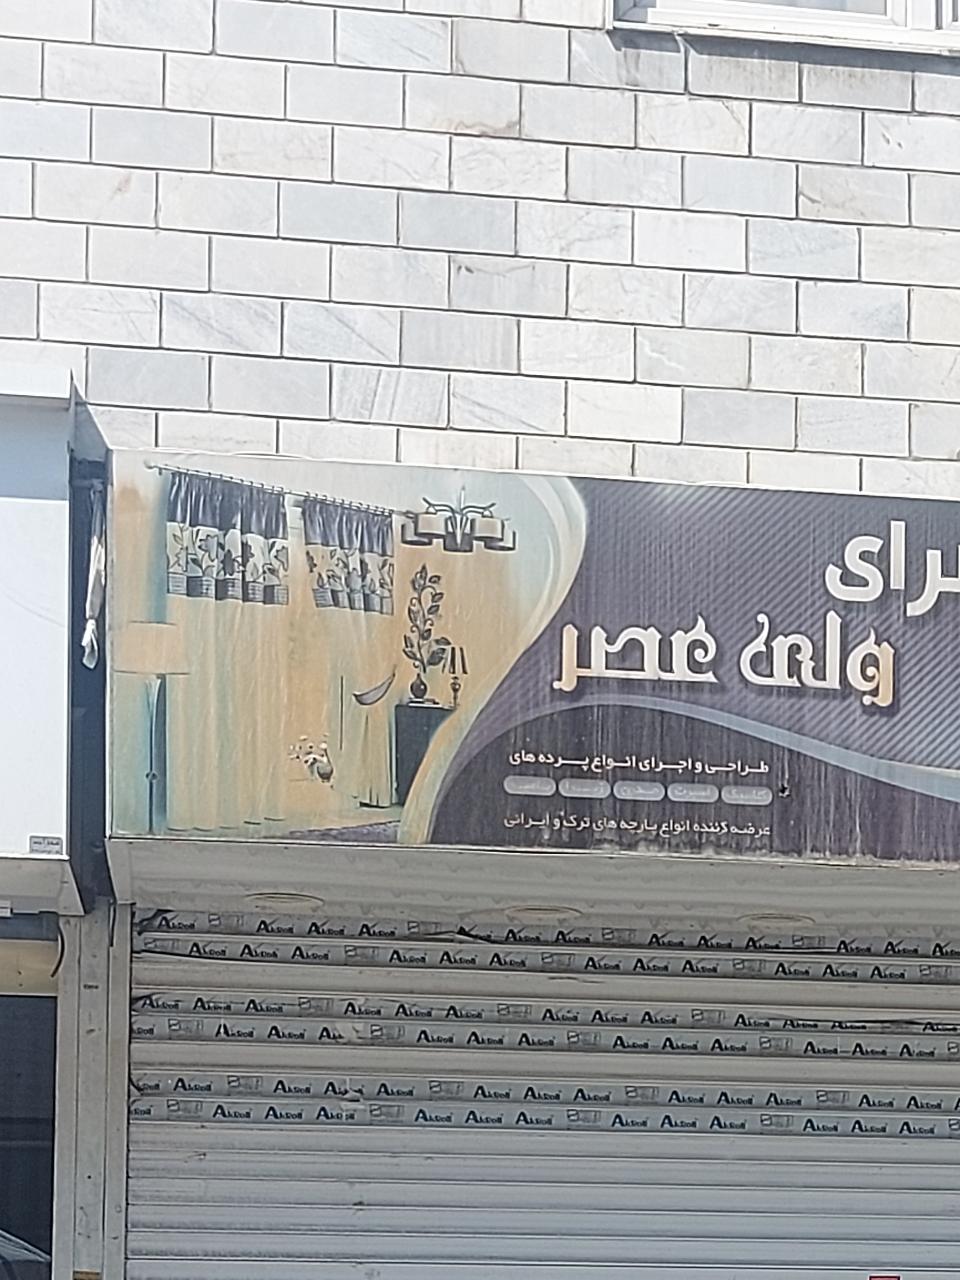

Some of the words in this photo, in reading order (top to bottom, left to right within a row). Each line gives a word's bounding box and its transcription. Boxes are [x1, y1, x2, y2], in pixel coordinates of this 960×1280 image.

[552, 615, 718, 691] عصر
[509, 750, 536, 765] های
[538, 753, 589, 771] پرده
[591, 755, 636, 773] انواع
[639, 757, 692, 775] اجرای
[694, 762, 702, 774] و
[705, 760, 769, 776] طراحی
[504, 813, 550, 829] ایرانی
[593, 816, 618, 831] های
[659, 820, 691, 837] انواع
[693, 821, 728, 835] کننده
[731, 823, 771, 838] عرضه
